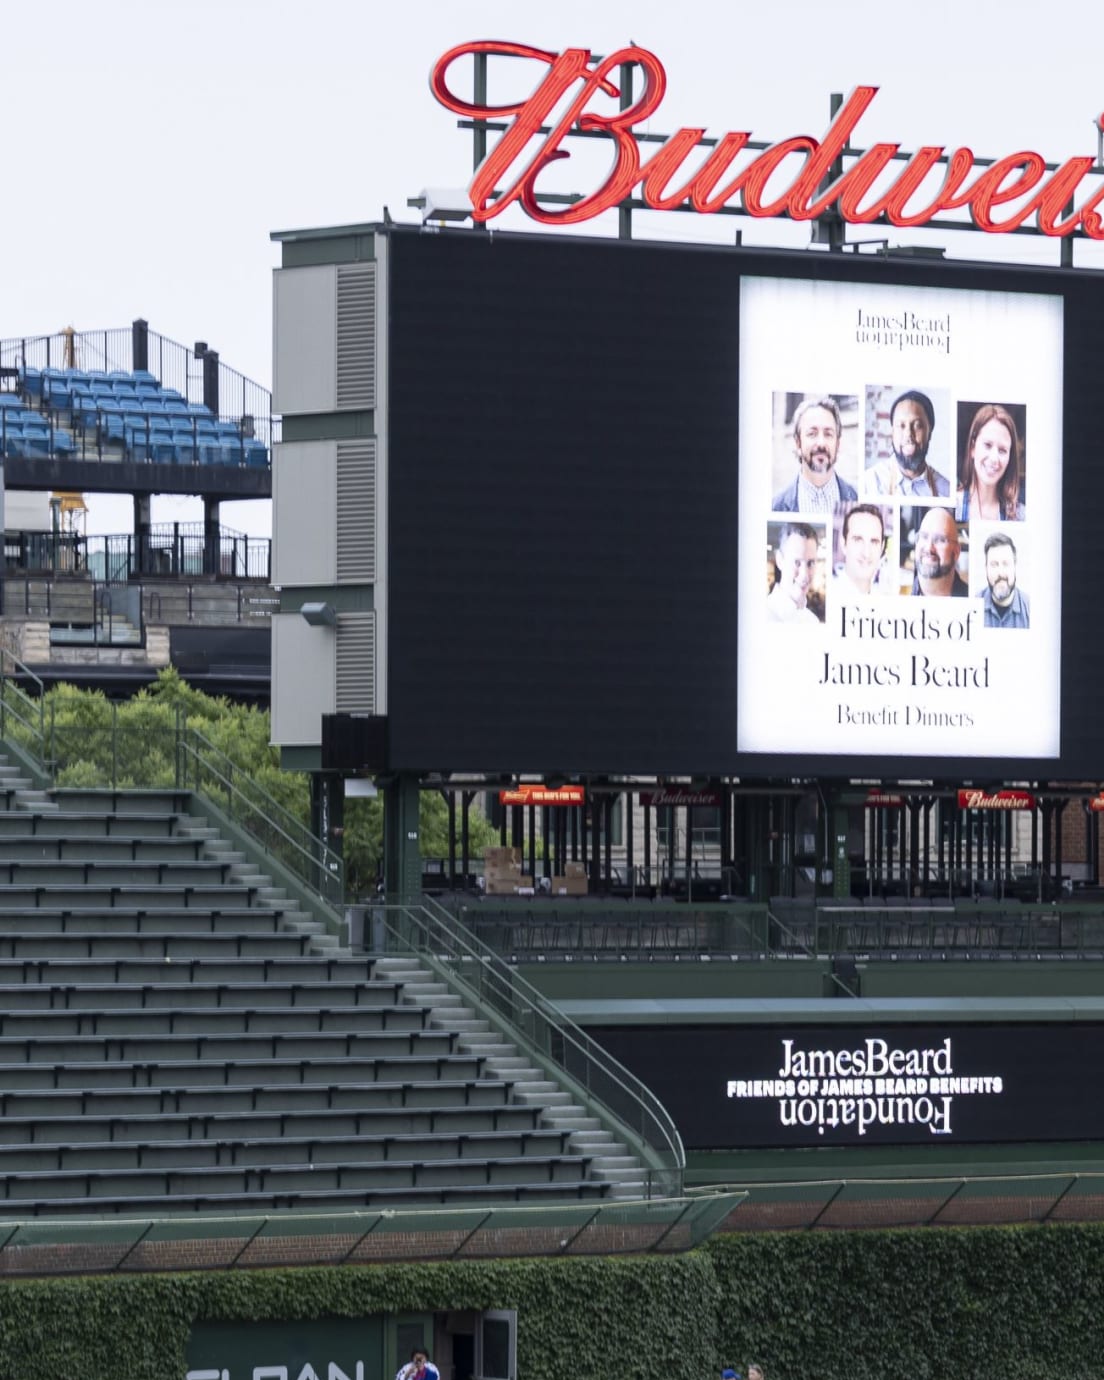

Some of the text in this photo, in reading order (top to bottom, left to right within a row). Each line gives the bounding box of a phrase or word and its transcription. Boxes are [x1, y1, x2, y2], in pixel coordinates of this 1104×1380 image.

[841, 606, 977, 641] Friends of
[819, 653, 989, 688] James Beard
[838, 704, 974, 727] Benefit Dinners
[966, 791, 1029, 808] Budweiser
[727, 1077, 1003, 1097] FRIENDS OF JAMES BEARD BENEFITS
